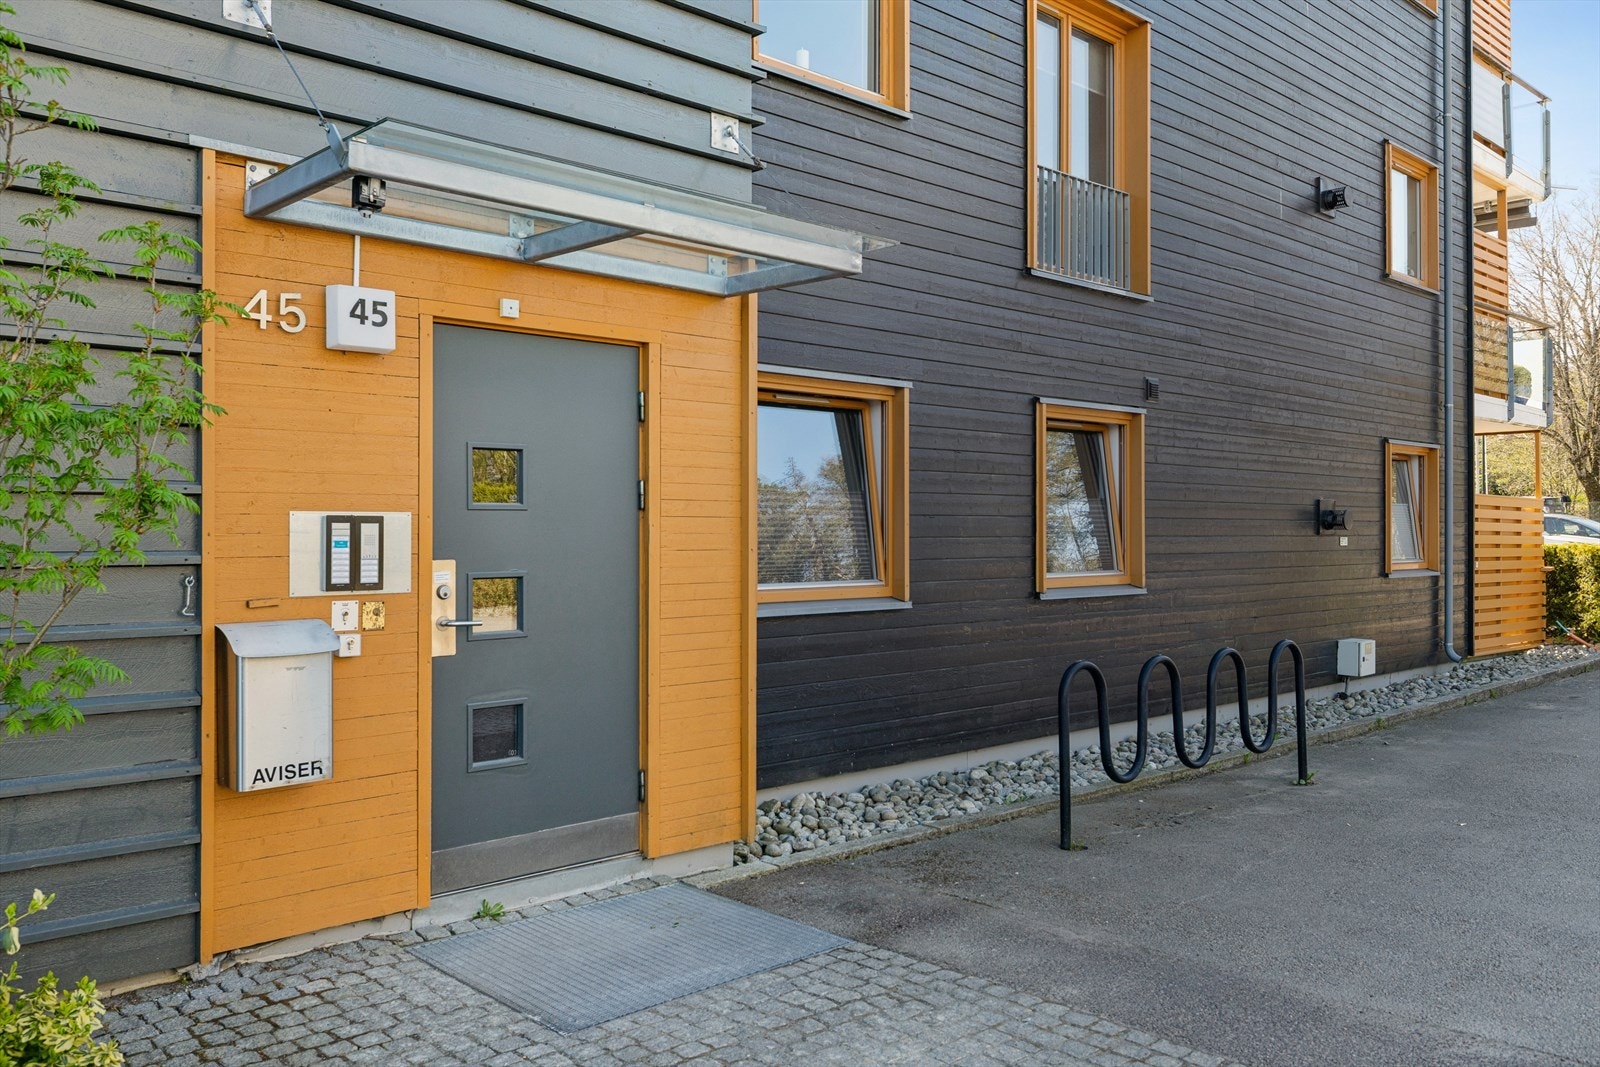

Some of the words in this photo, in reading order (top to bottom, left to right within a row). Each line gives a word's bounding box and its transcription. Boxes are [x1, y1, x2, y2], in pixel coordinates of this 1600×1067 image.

[242, 289, 307, 333] 45
[350, 298, 388, 327] 45
[252, 760, 323, 785] AVISER
